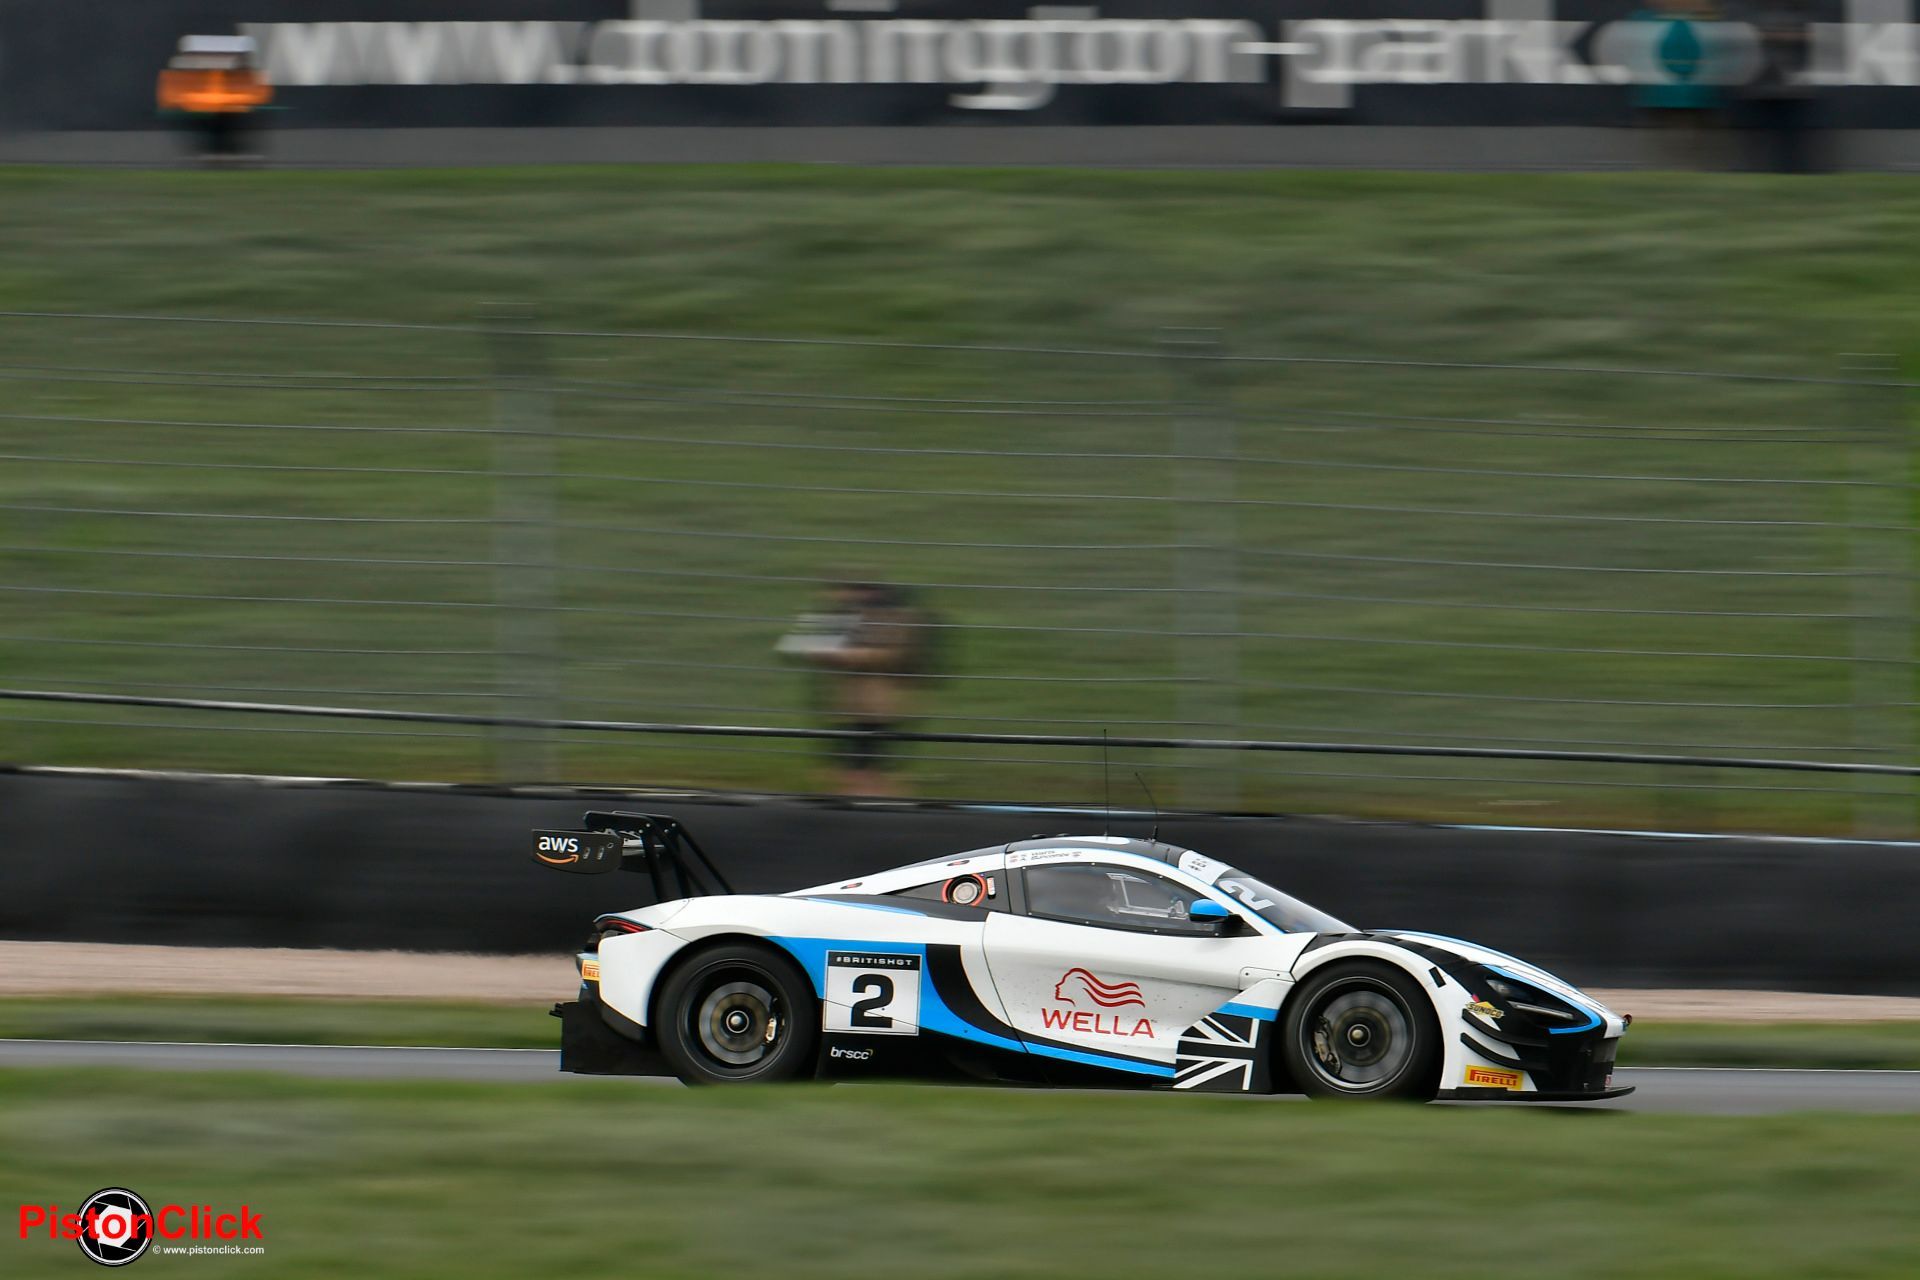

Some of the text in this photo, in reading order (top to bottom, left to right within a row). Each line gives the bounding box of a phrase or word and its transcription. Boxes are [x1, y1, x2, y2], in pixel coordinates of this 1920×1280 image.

[538, 836, 578, 853] aws
[1218, 880, 1276, 910] 2
[835, 955, 913, 967] #BRITISHGT
[850, 973, 894, 1028] 2
[1466, 1002, 1502, 1018] SUNOCO
[1041, 1007, 1155, 1039] WELLA
[830, 1047, 871, 1060] brscc
[1469, 1069, 1518, 1087] PIRELLI
